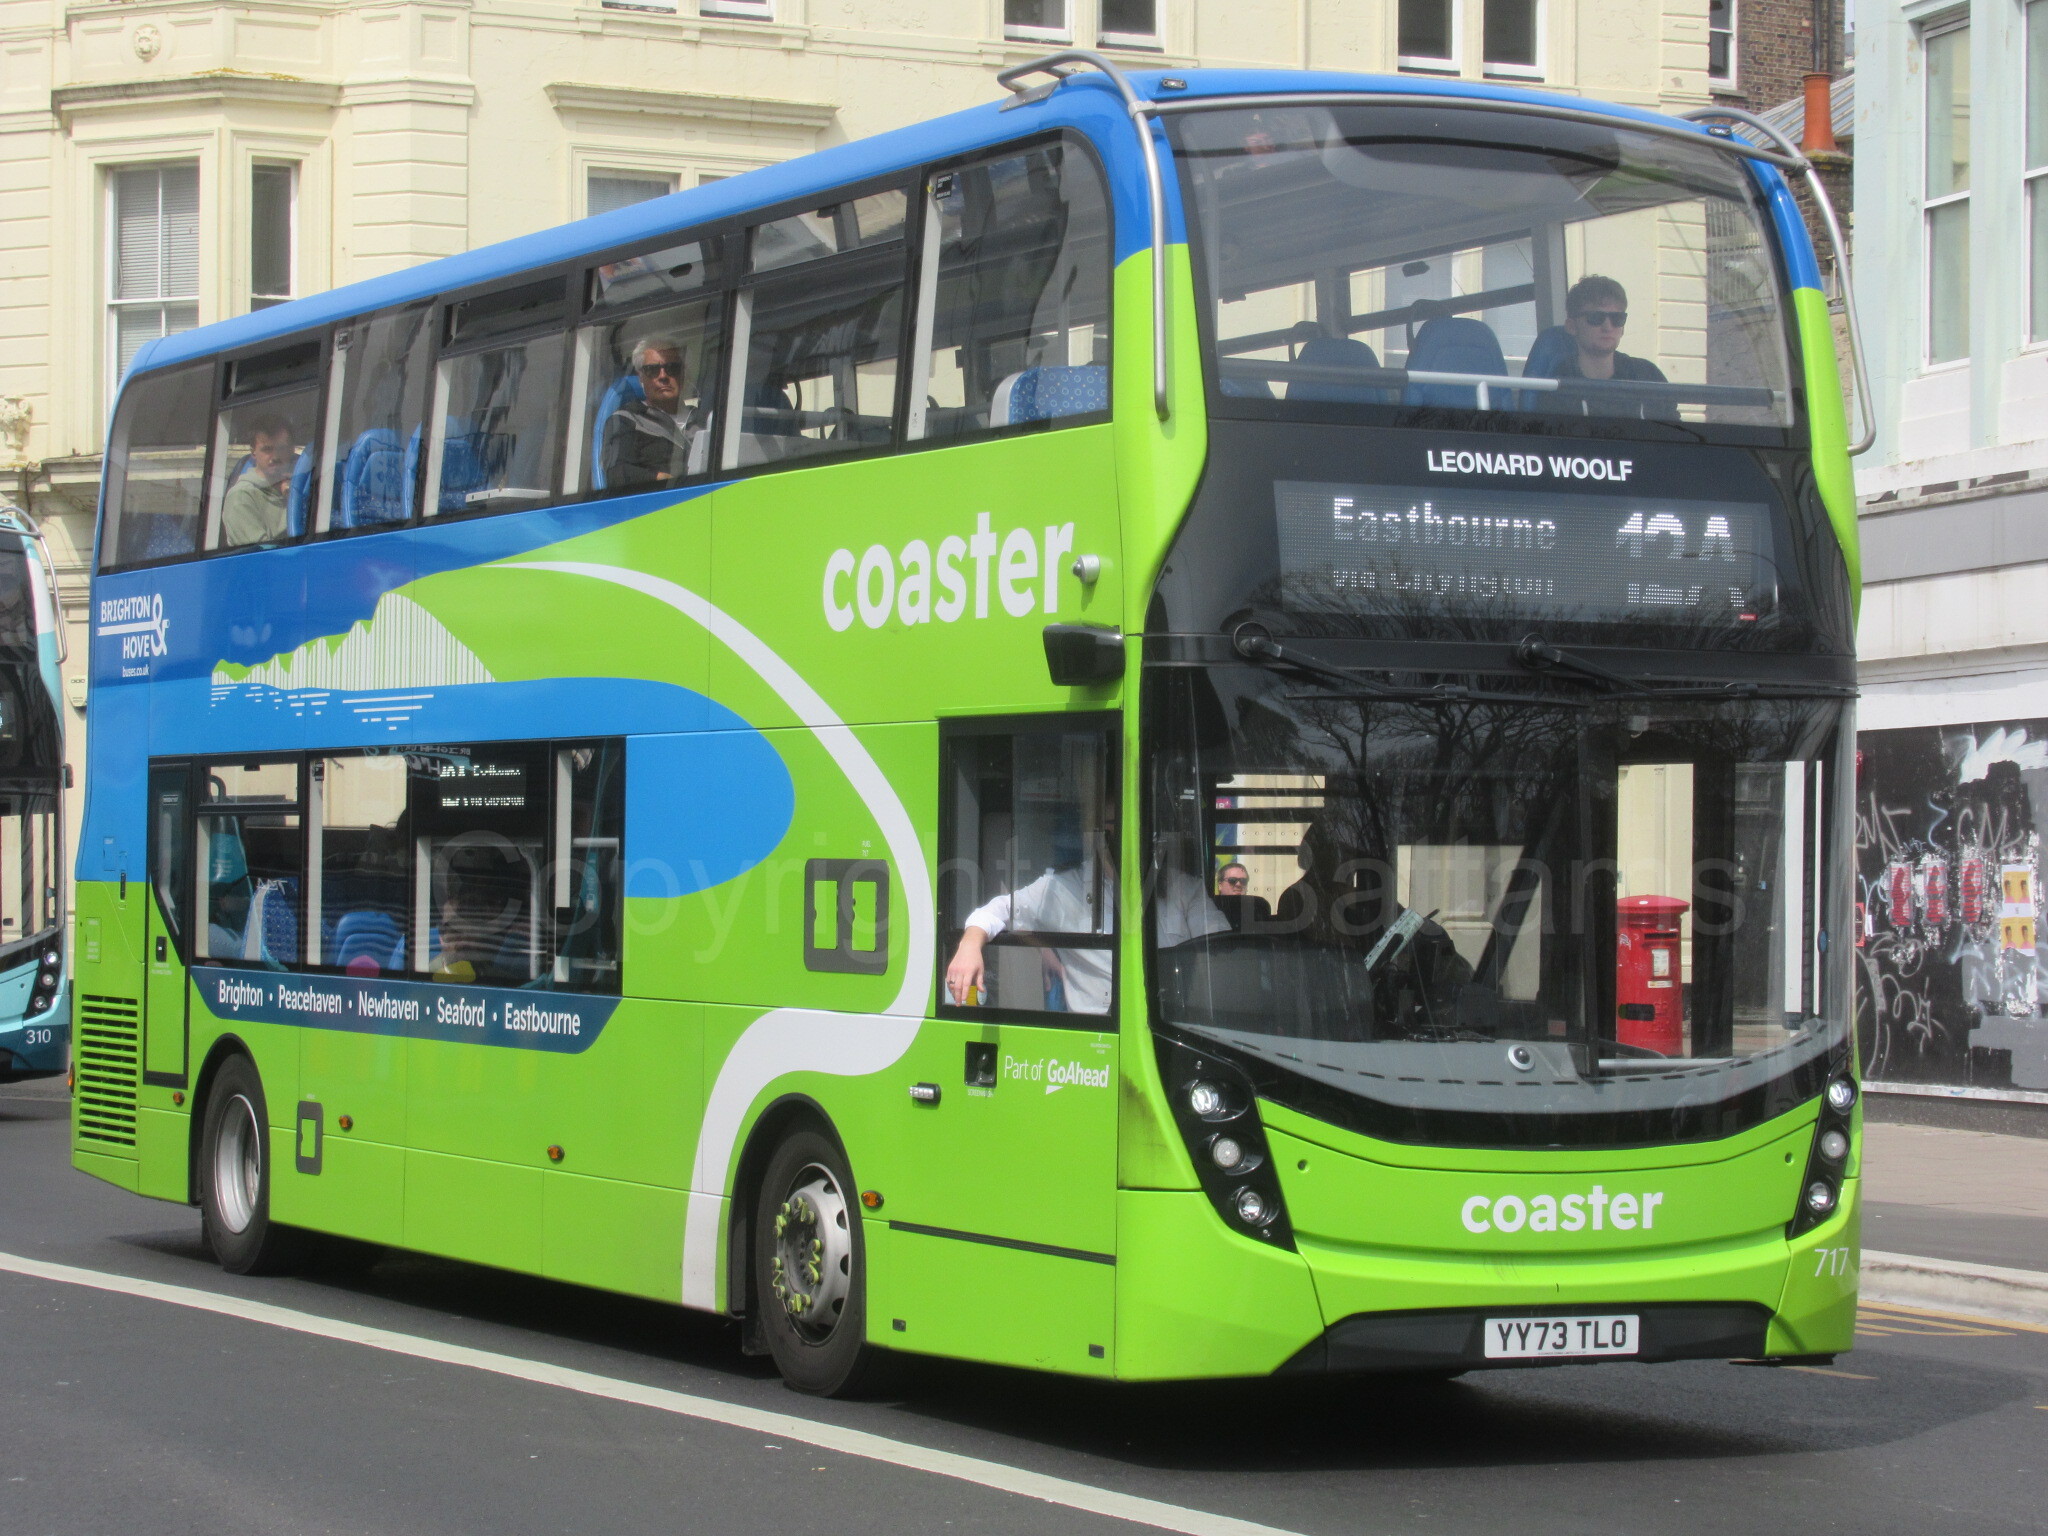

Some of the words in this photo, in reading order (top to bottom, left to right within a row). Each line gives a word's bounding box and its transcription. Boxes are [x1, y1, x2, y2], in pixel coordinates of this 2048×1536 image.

[1427, 450, 1543, 477] LEONARD
[1549, 456, 1633, 481] WOOLF
[1333, 497, 1556, 550] Eastbourne
[823, 512, 1074, 632] coaster
[101, 595, 150, 623] BRIGHTON
[123, 635, 150, 659] HOVE
[122, 664, 149, 677] buses.co.uk
[219, 978, 263, 1011] Brighton
[278, 984, 342, 1014] Peacehaven
[358, 991, 419, 1020] Newhaven
[437, 997, 485, 1027] Seaford
[505, 1002, 581, 1035] Eastbourne
[26, 1029, 51, 1044] 310
[1004, 1056, 1029, 1080] Part
[1031, 1058, 1044, 1081] of
[1047, 1058, 1110, 1088] GoAhead
[1461, 1185, 1664, 1233] coaster
[1814, 1247, 1849, 1277] 717
[1498, 1321, 1568, 1351] YY73
[1576, 1320, 1627, 1349] TLO
